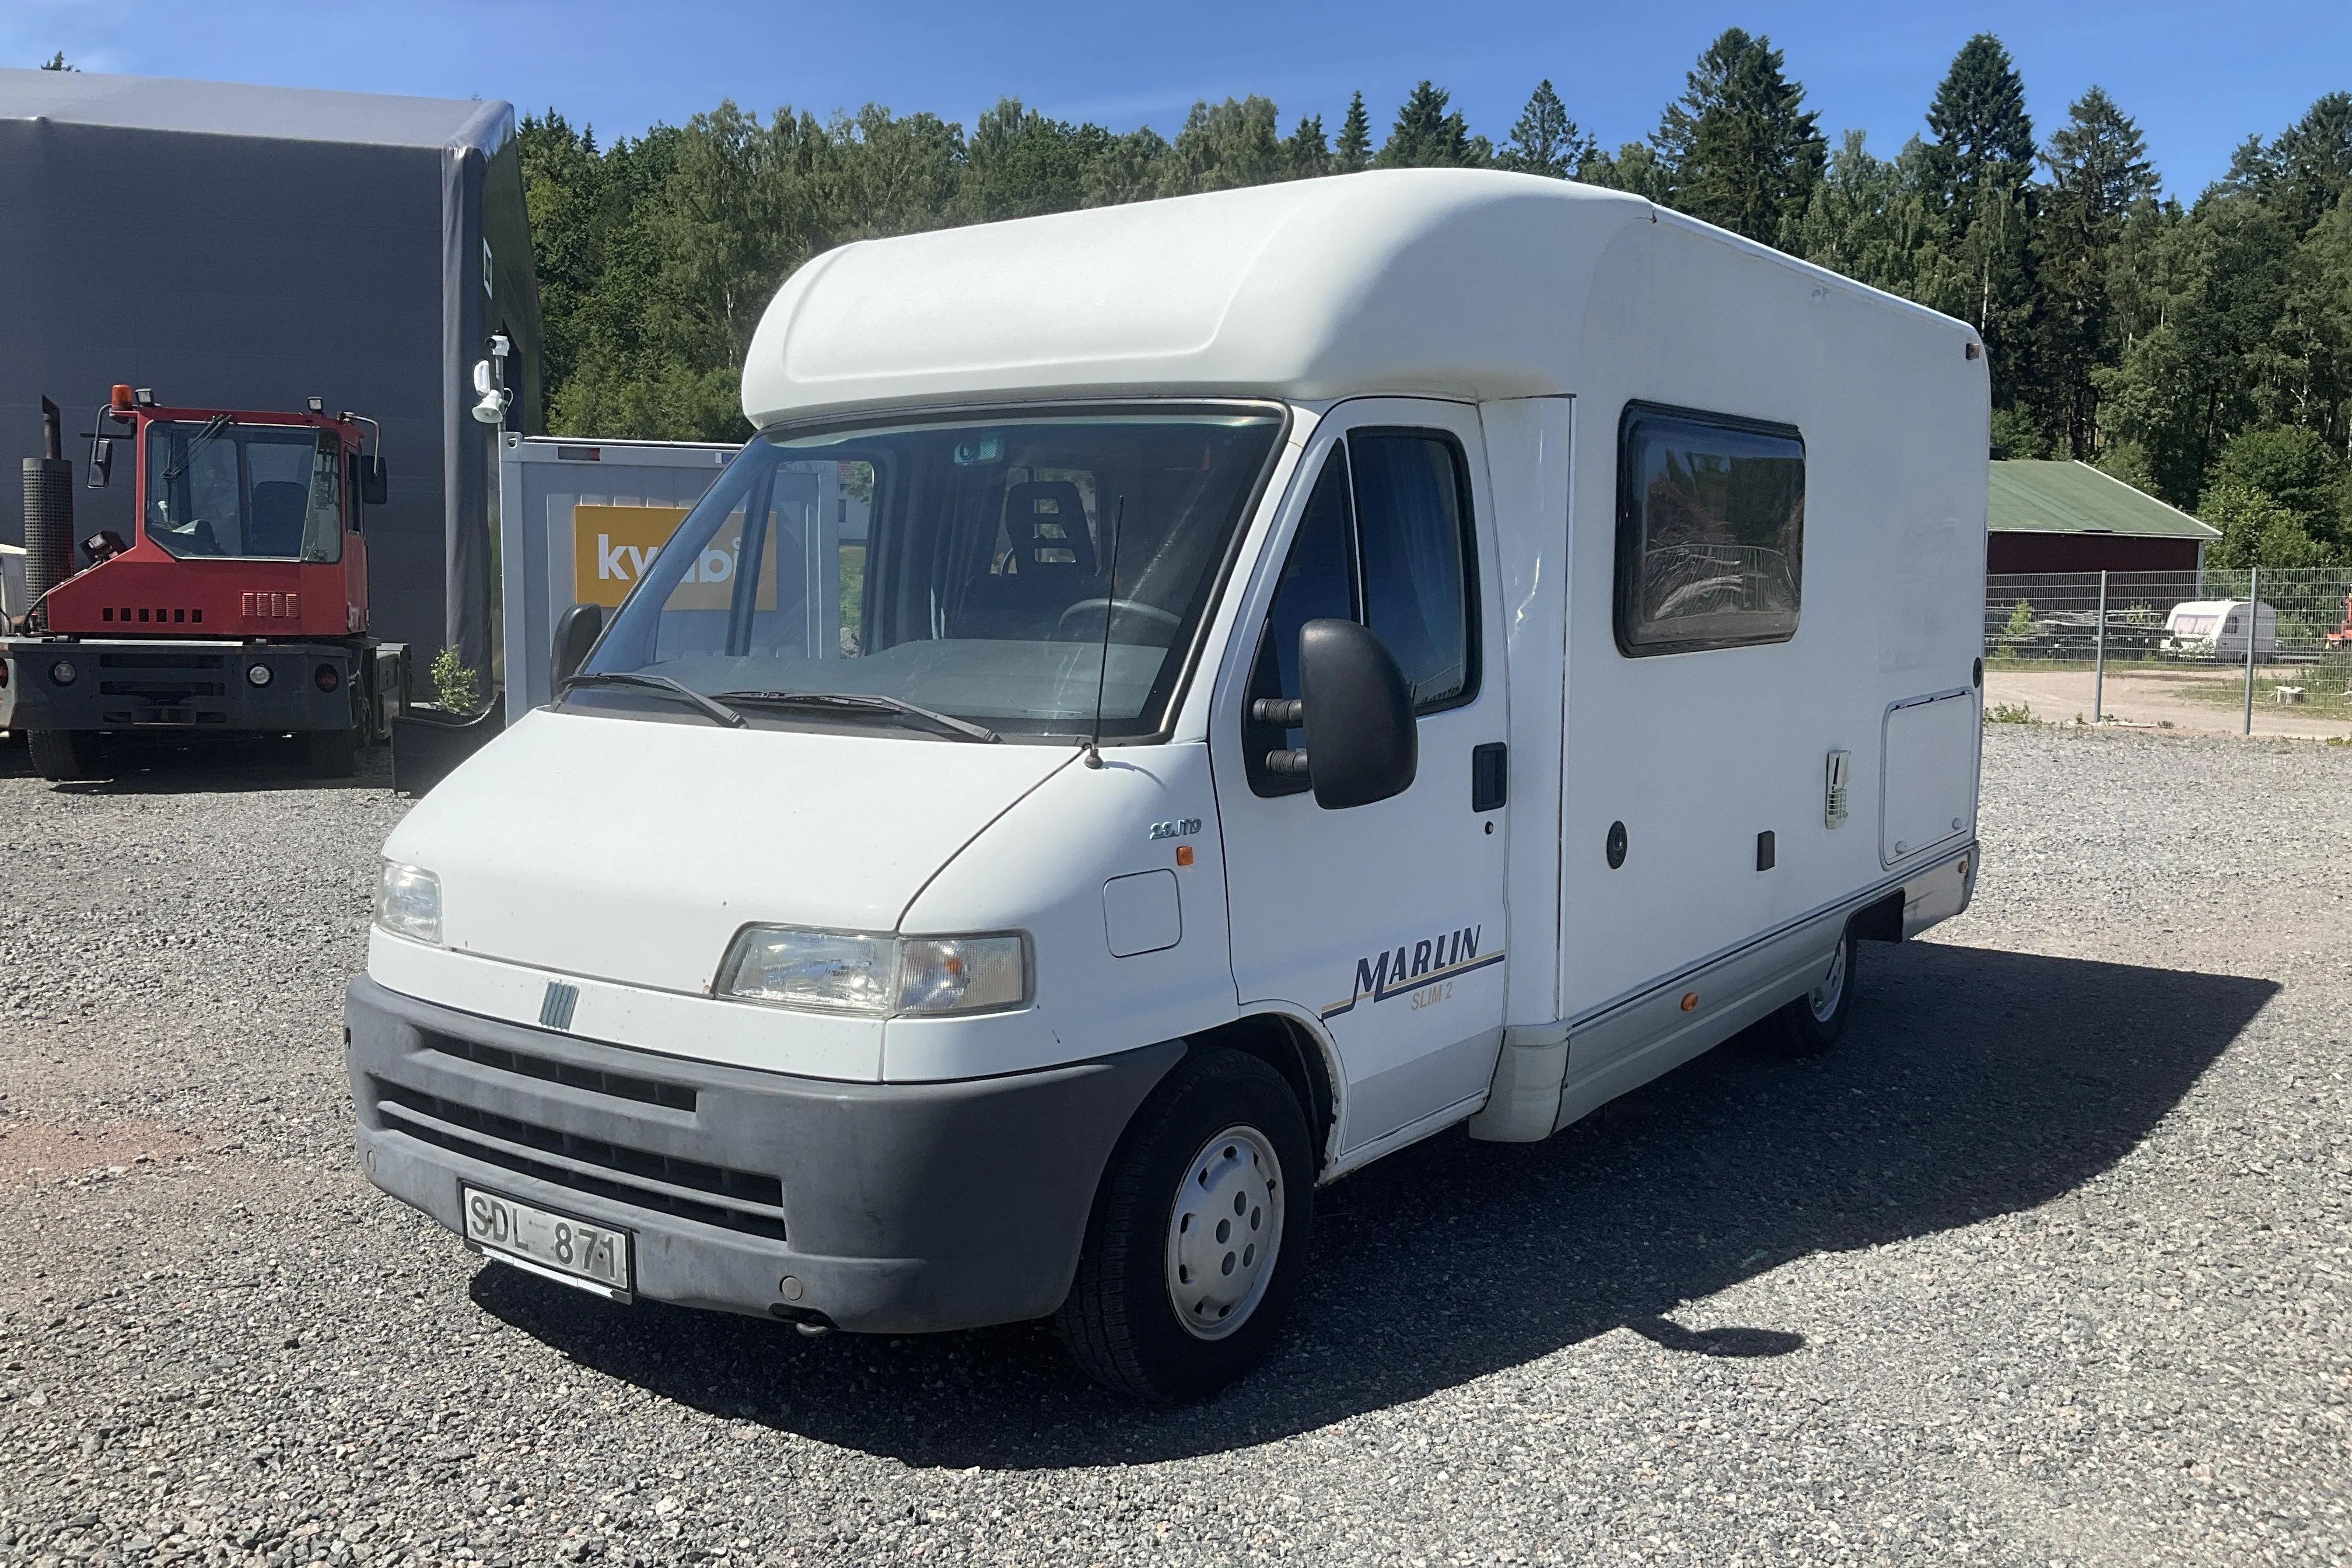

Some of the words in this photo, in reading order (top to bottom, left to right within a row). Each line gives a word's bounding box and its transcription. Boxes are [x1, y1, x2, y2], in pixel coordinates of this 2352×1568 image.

[1351, 924, 1481, 1005] MARLIN
[1412, 984, 1443, 1011] SLIM
[1446, 981, 1453, 999] 2
[471, 1196, 528, 1251] SDL
[555, 1222, 615, 1279] 871
